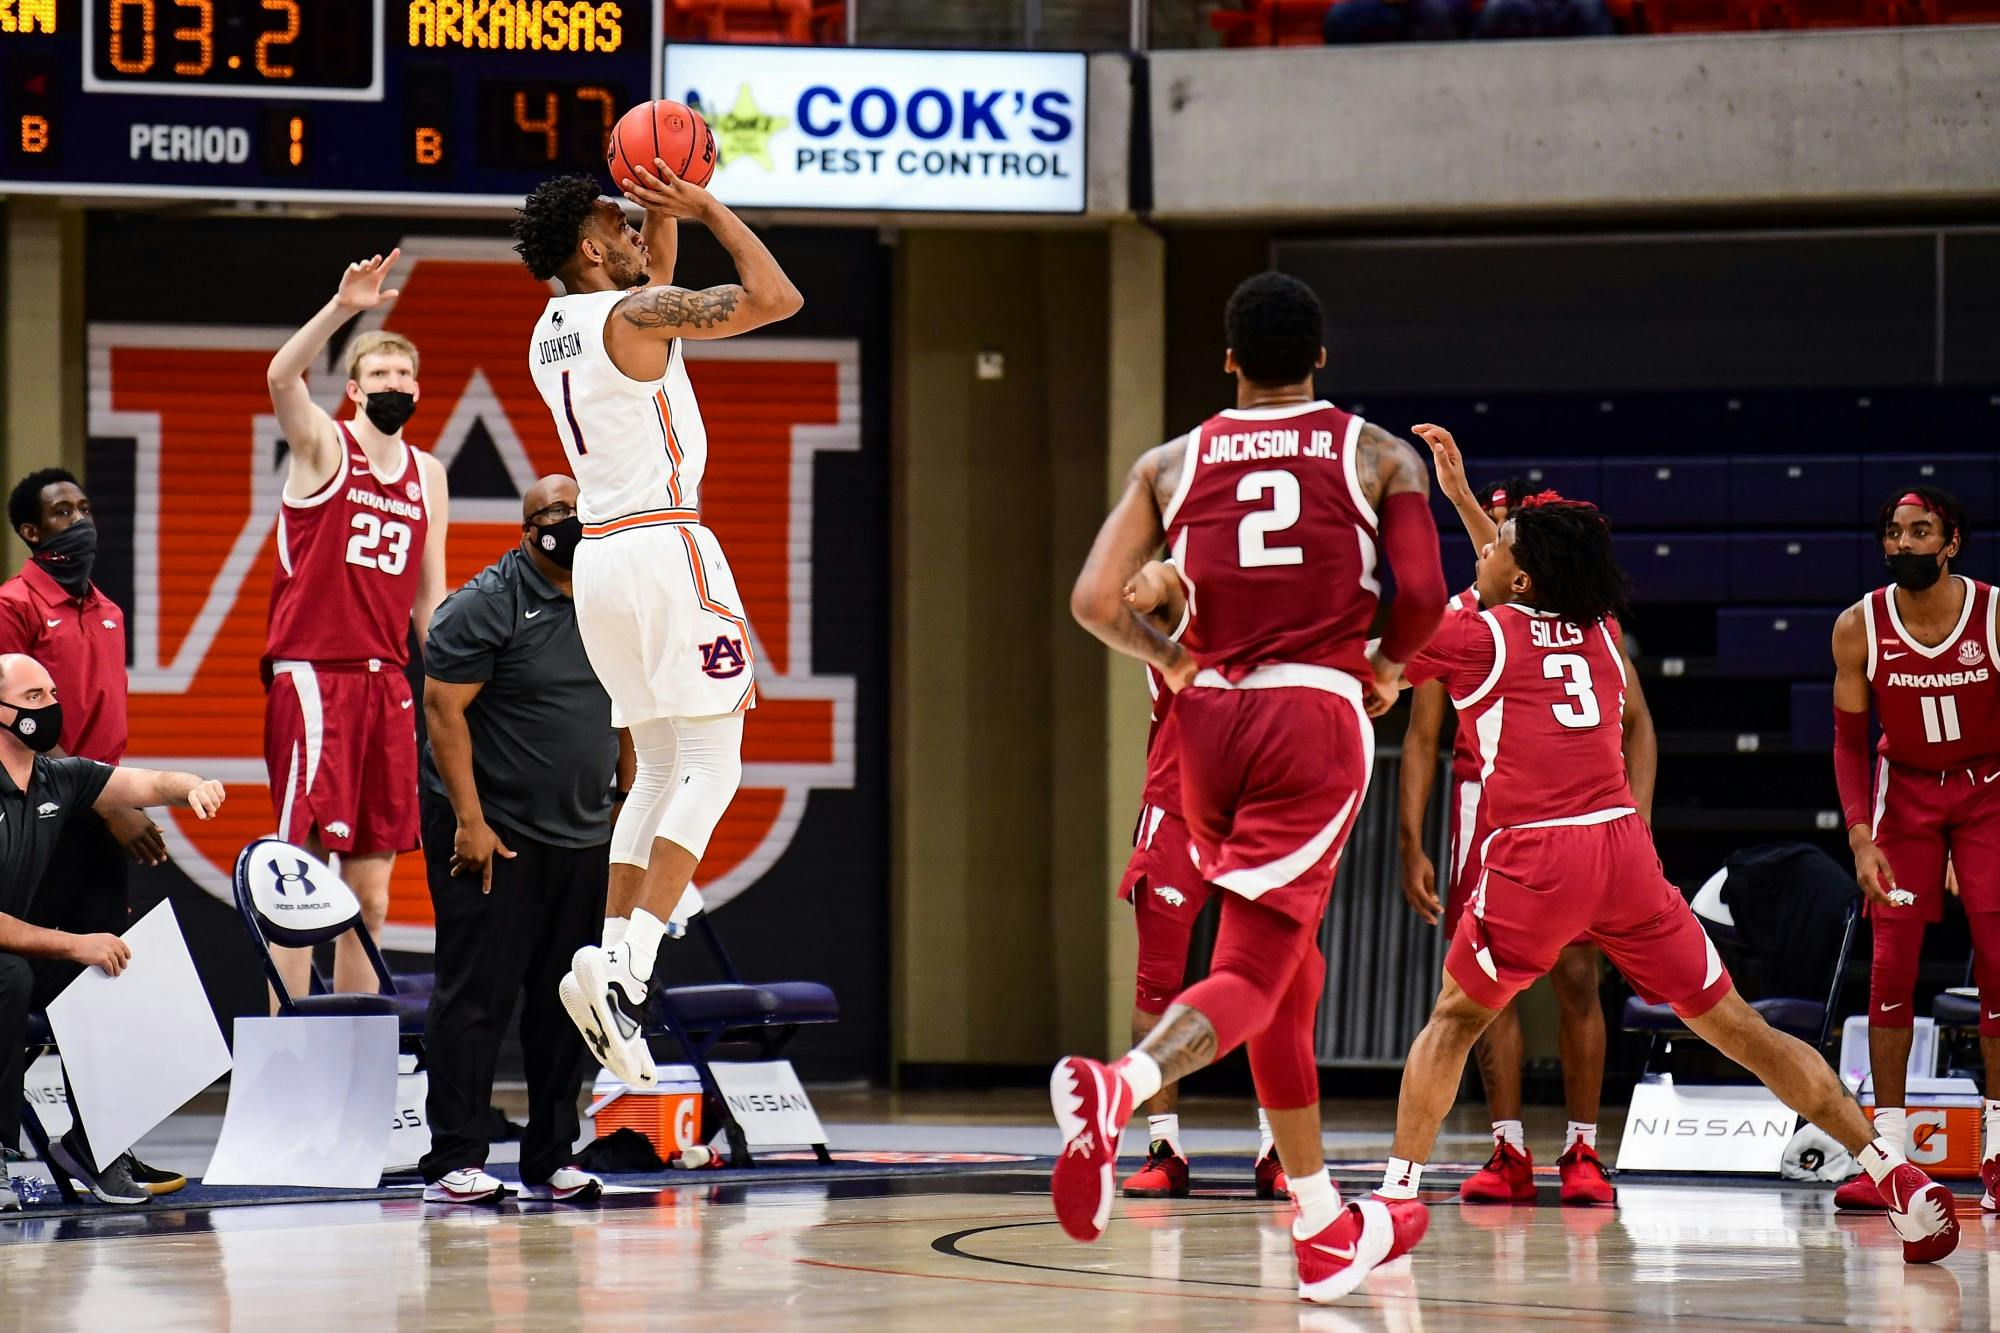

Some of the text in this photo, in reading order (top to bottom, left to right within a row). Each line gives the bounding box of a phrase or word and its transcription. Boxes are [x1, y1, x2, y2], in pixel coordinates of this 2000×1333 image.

[110, 0, 300, 78] 03.2
[409, 0, 622, 52] ARKANSAS
[21, 115, 48, 152] B
[514, 87, 614, 160] 47
[796, 85, 1072, 142] COOK'S
[130, 124, 249, 163] PERIOD
[289, 116, 303, 166] 1
[416, 127, 442, 164] B
[796, 149, 1069, 178] PEST CONTROL
[539, 332, 582, 365] JOHNSON
[561, 369, 588, 456] 1
[1202, 429, 1338, 464] JACKSON JR.
[346, 487, 421, 521] ARKANSAS
[1236, 469, 1304, 567] 2
[345, 512, 412, 576] 23
[1530, 620, 1584, 648] SILLS
[1543, 654, 1601, 728] 3
[1887, 668, 1989, 688] ARKANSAS
[1920, 695, 1961, 743] 11
[727, 1094, 808, 1112] NISSAN
[1633, 1117, 1788, 1137] NISSAN
[1905, 1110, 1948, 1164] G
